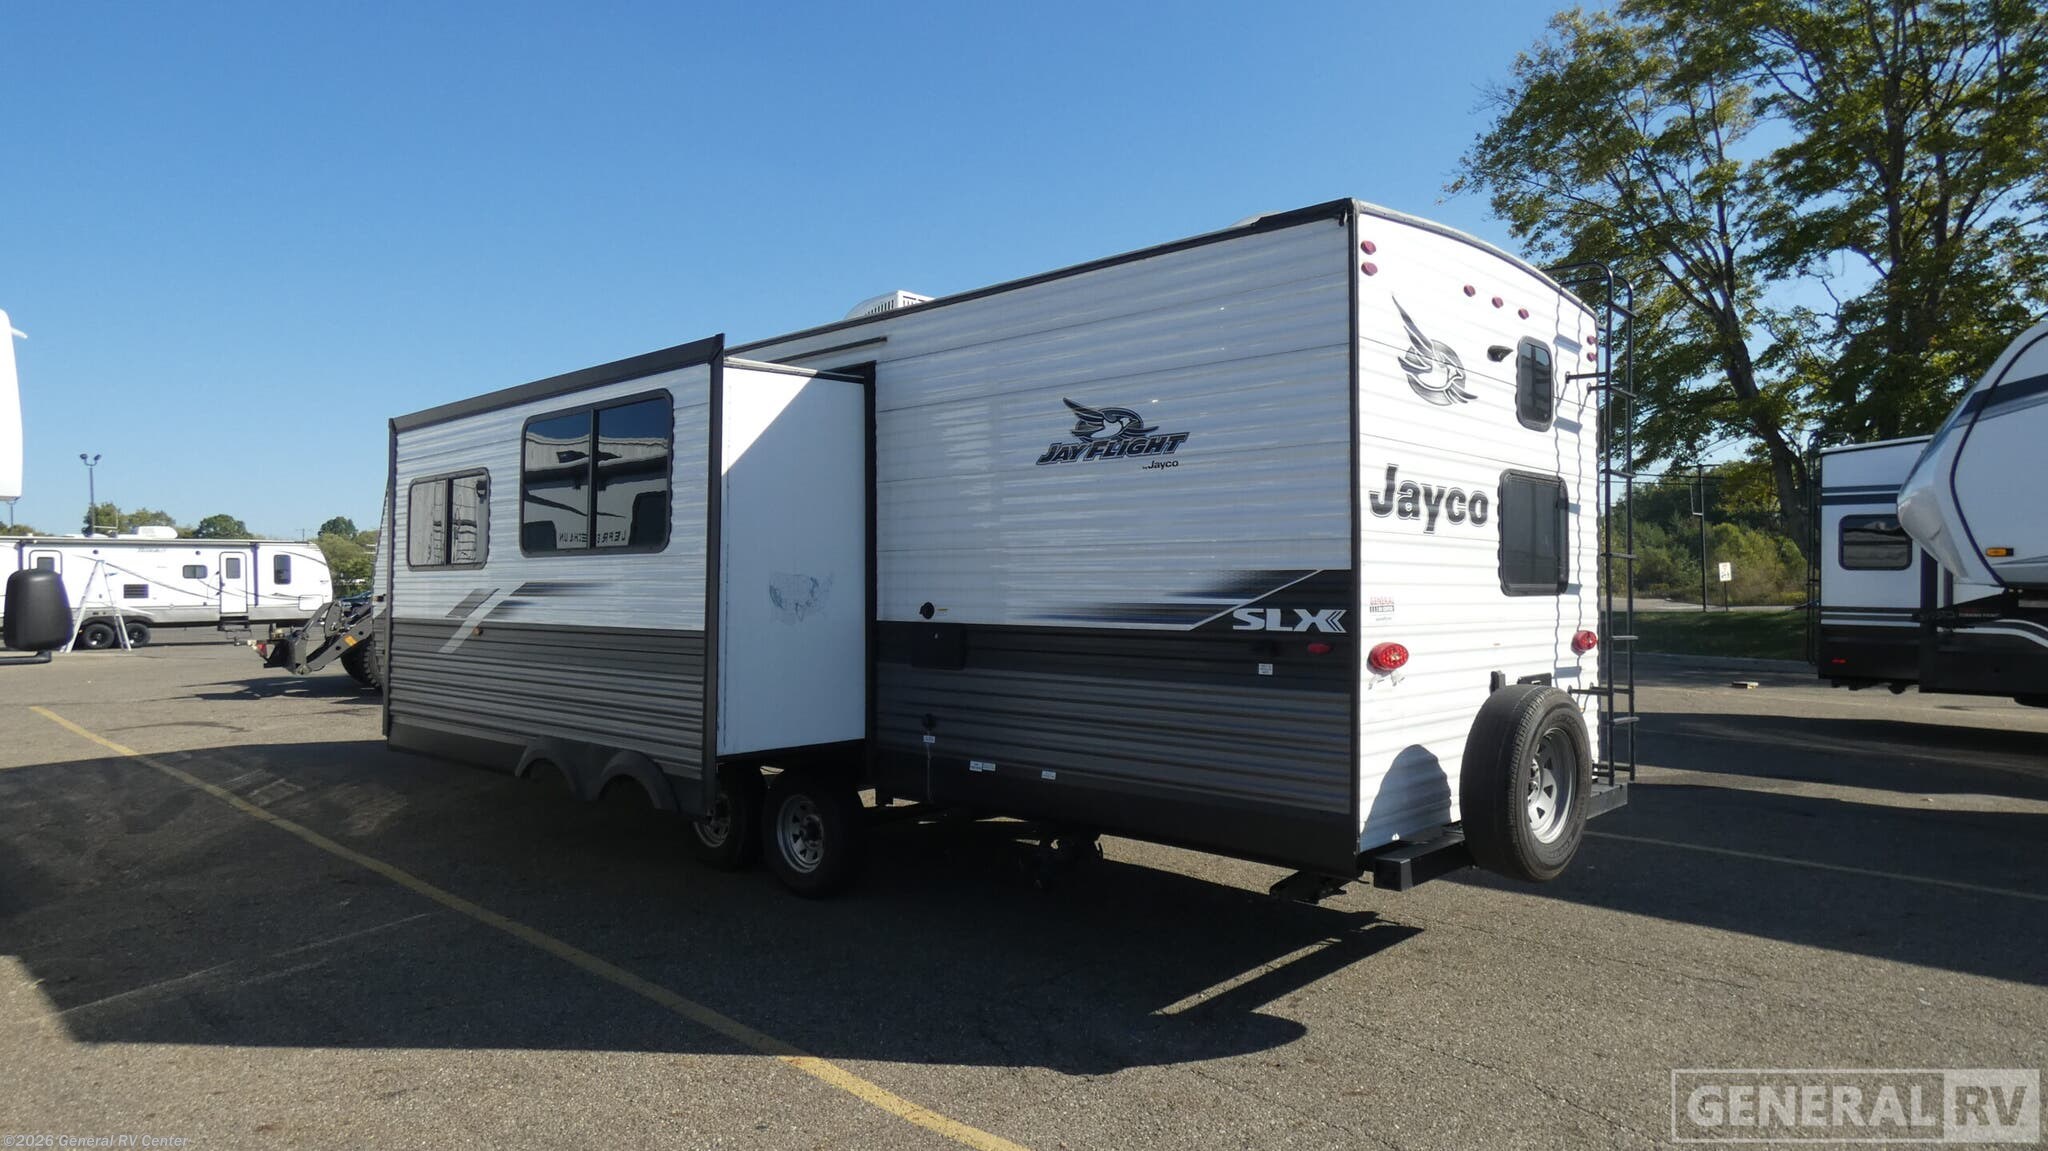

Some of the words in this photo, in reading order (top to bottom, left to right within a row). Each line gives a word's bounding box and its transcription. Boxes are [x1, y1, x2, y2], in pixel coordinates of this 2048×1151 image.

[1037, 443, 1091, 465] JAY
[1084, 432, 1189, 462] FLIGHT
[1148, 460, 1179, 470] Jayco
[1368, 463, 1489, 534] Jayco
[1233, 608, 1347, 633] SLX
